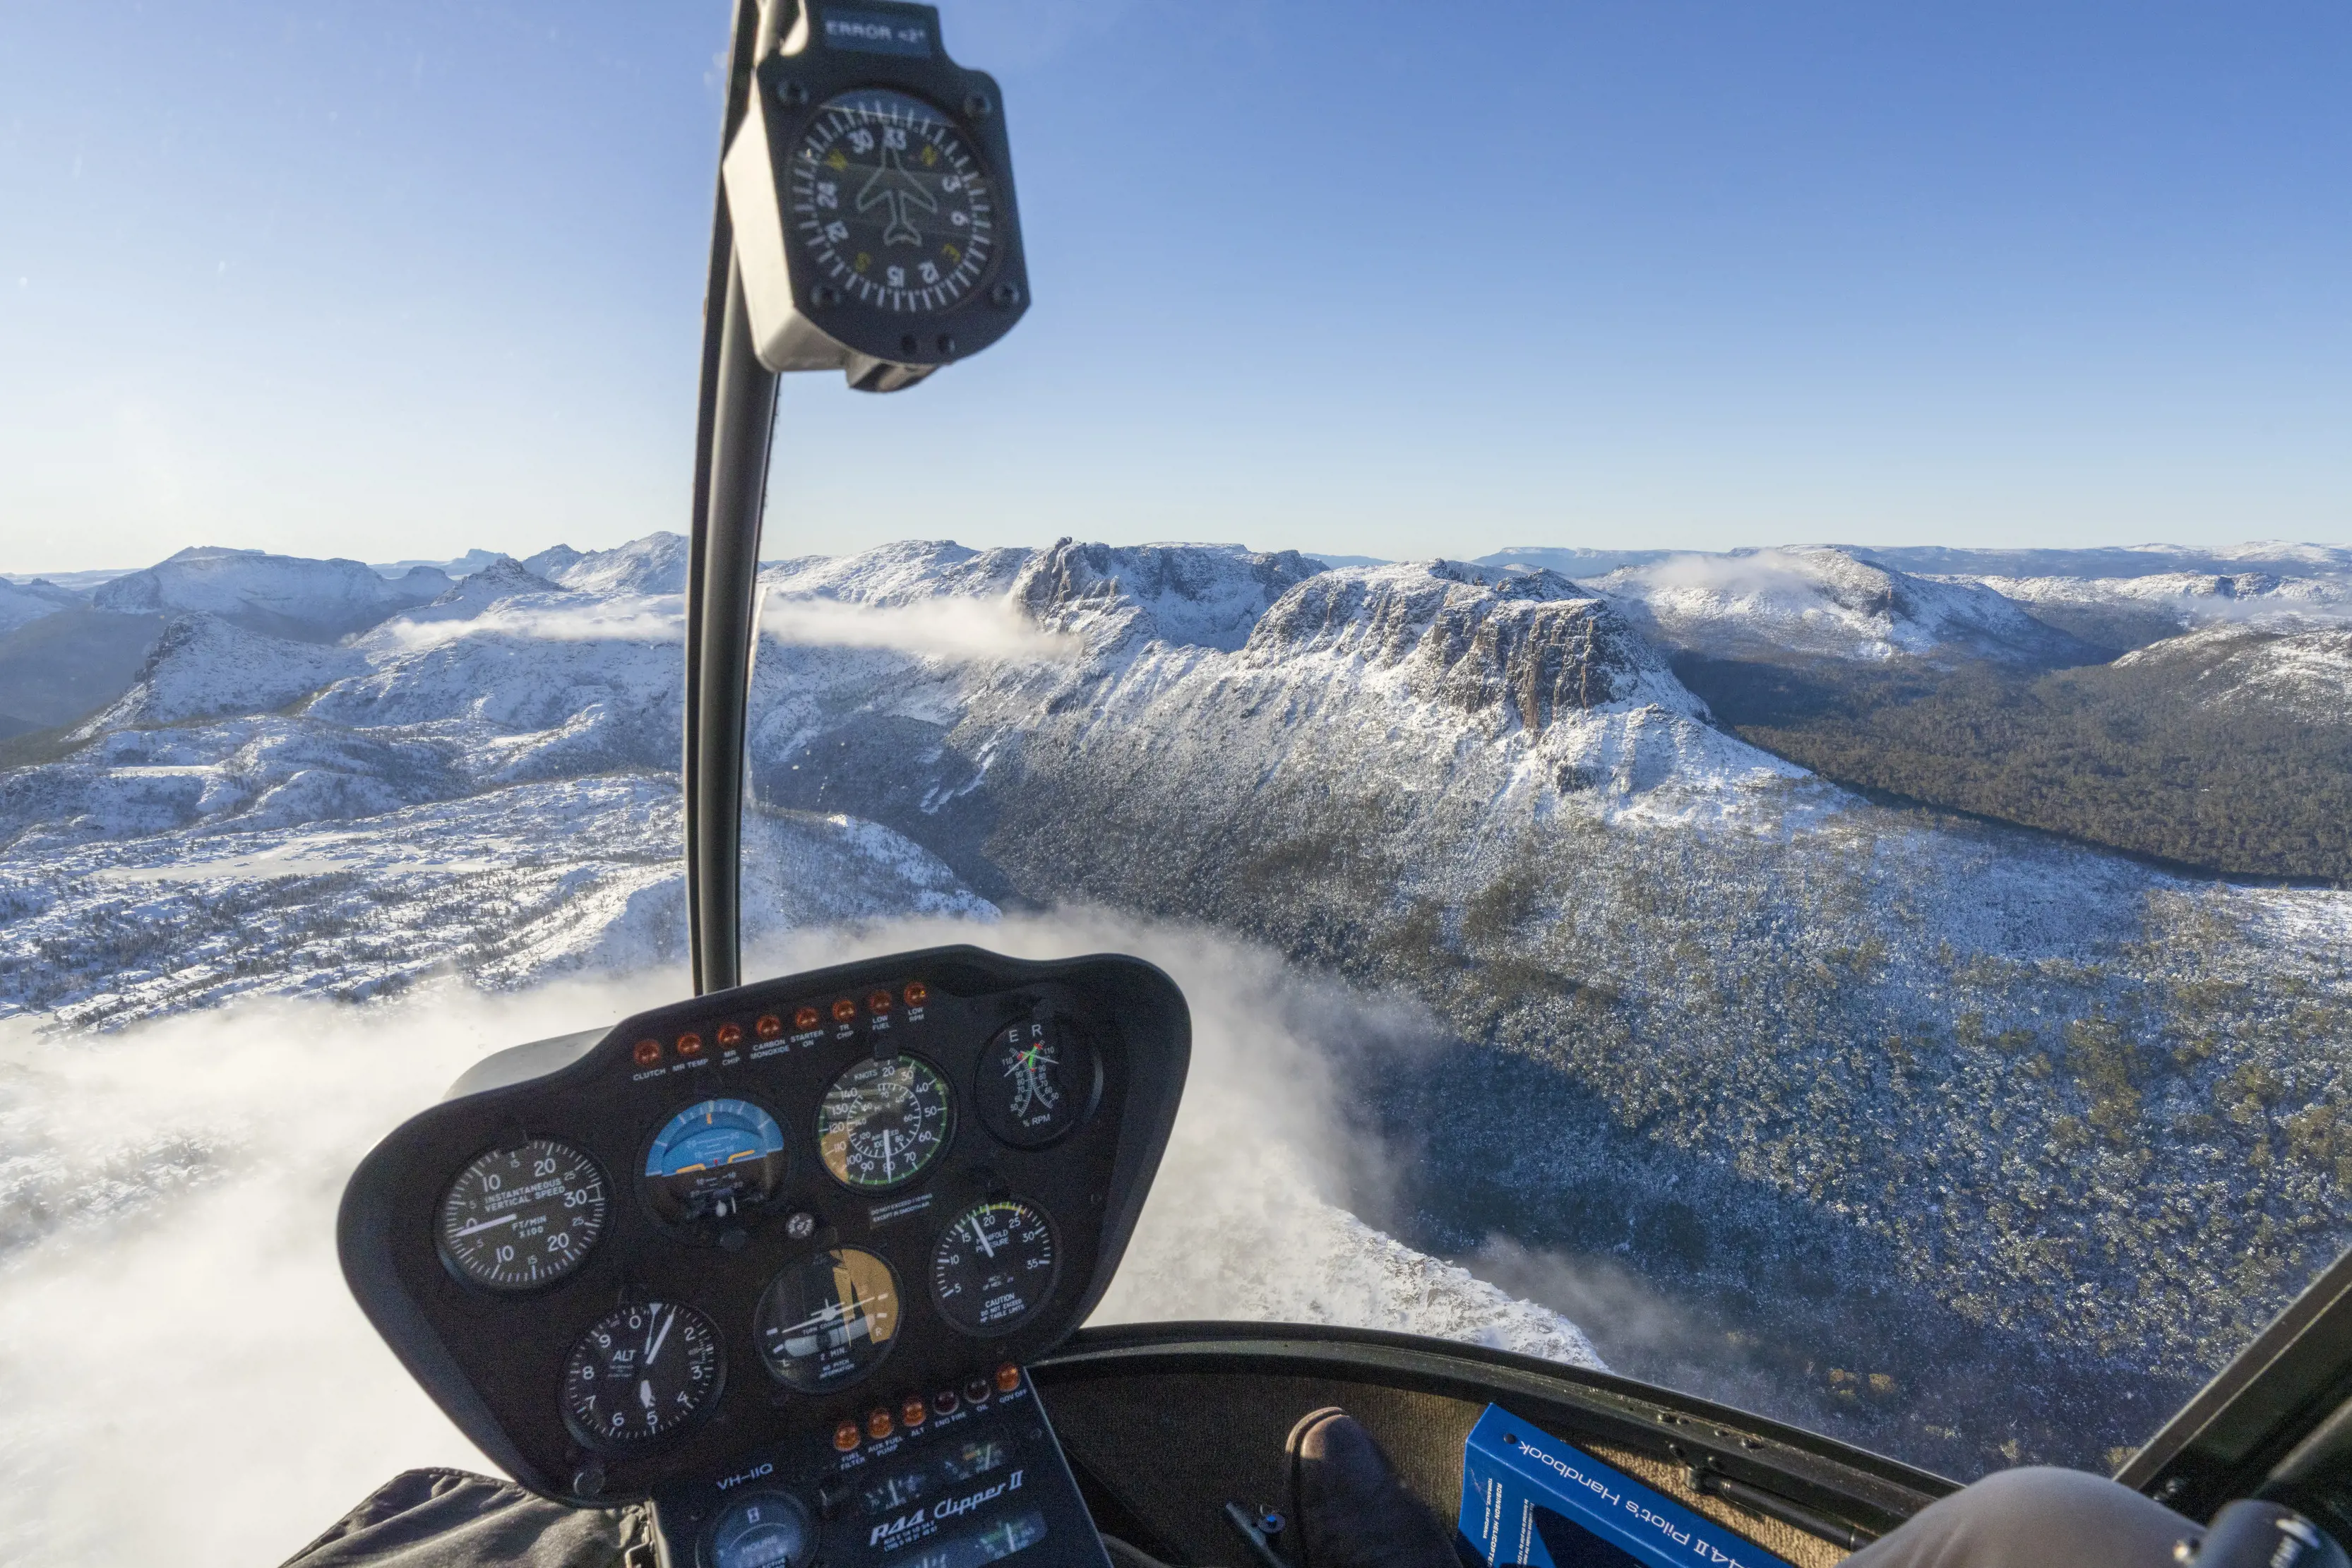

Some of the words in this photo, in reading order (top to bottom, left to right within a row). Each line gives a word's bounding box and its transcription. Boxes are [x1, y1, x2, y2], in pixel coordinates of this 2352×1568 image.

[825, 20, 893, 40] ERROR
[848, 128, 874, 154] 30
[942, 176, 962, 193] 3
[950, 211, 969, 227] 6
[907, 1007, 924, 1015] LOW
[873, 1015, 888, 1024] LOW
[909, 1014, 924, 1022] RPM
[872, 1022, 890, 1031] FUEL
[790, 1029, 825, 1043] STARTER
[837, 1030, 854, 1040] CHIP
[1008, 1030, 1019, 1043] E
[1032, 1024, 1042, 1036] R
[753, 1039, 786, 1051] CARBON
[802, 1039, 815, 1048] ON
[750, 1045, 790, 1059] MONOXIDE
[672, 1063, 686, 1072] MR
[687, 1058, 709, 1068] TEMP
[722, 1056, 741, 1066] CHIP
[633, 1067, 667, 1081] CLUTCH
[854, 1070, 878, 1081] KNOTS
[881, 1066, 895, 1077] 20
[901, 1070, 914, 1082] 30
[916, 1082, 929, 1094] 40
[832, 1103, 849, 1115] 130
[924, 1106, 938, 1118] 50
[1032, 1114, 1051, 1125] RPM
[828, 1122, 844, 1134] 120
[919, 1130, 932, 1142] 60
[847, 1153, 862, 1165] 100
[904, 1151, 917, 1163] 70
[534, 1158, 556, 1178] 20
[860, 1160, 874, 1172] 90
[563, 1171, 575, 1181] 25
[482, 1174, 501, 1192] 10
[484, 1178, 562, 1204] INSTANTANEOUS
[469, 1199, 477, 1209] 5
[484, 1196, 532, 1213] VERTICAL
[535, 1185, 566, 1200] SPEED
[563, 1189, 587, 1208] 30
[512, 1214, 547, 1231] FT/MIN
[572, 1216, 584, 1226] 25
[983, 1215, 996, 1227] 20
[1008, 1217, 1021, 1229] 25
[547, 1233, 569, 1252] 20
[962, 1232, 972, 1243] 15
[1022, 1231, 1034, 1243] 30
[476, 1239, 484, 1249] 5
[496, 1245, 515, 1263] 10
[527, 1255, 537, 1265] 15
[950, 1255, 960, 1265] 10
[1027, 1258, 1039, 1269] 35
[954, 1283, 962, 1293] 5
[985, 1293, 1015, 1308] CAUTION
[628, 1315, 642, 1329] 0
[684, 1327, 696, 1341] 2
[875, 1327, 883, 1336] R
[599, 1334, 611, 1348] 9
[613, 1349, 636, 1362] ALT
[582, 1365, 595, 1380] 8
[691, 1365, 703, 1380] 3
[585, 1394, 597, 1410] 7
[676, 1391, 689, 1404] 4
[612, 1412, 624, 1427] 6
[646, 1411, 658, 1426] 5
[951, 1412, 967, 1422] FIRE
[911, 1427, 924, 1437] ALT
[868, 1443, 883, 1453] AUX
[885, 1435, 903, 1447] FUEL
[877, 1444, 898, 1456] PUMP
[842, 1452, 859, 1461] FUEL
[840, 1456, 866, 1471] FILTER
[1518, 1441, 1620, 1507] Handbook
[869, 1509, 924, 1546] R44
[933, 1483, 1006, 1519] Clipper
[1009, 1469, 1023, 1491] II
[1494, 1483, 1503, 1520] ROBINSON
[1625, 1500, 1691, 1546] Pilot's
[1693, 1539, 1709, 1556] II
